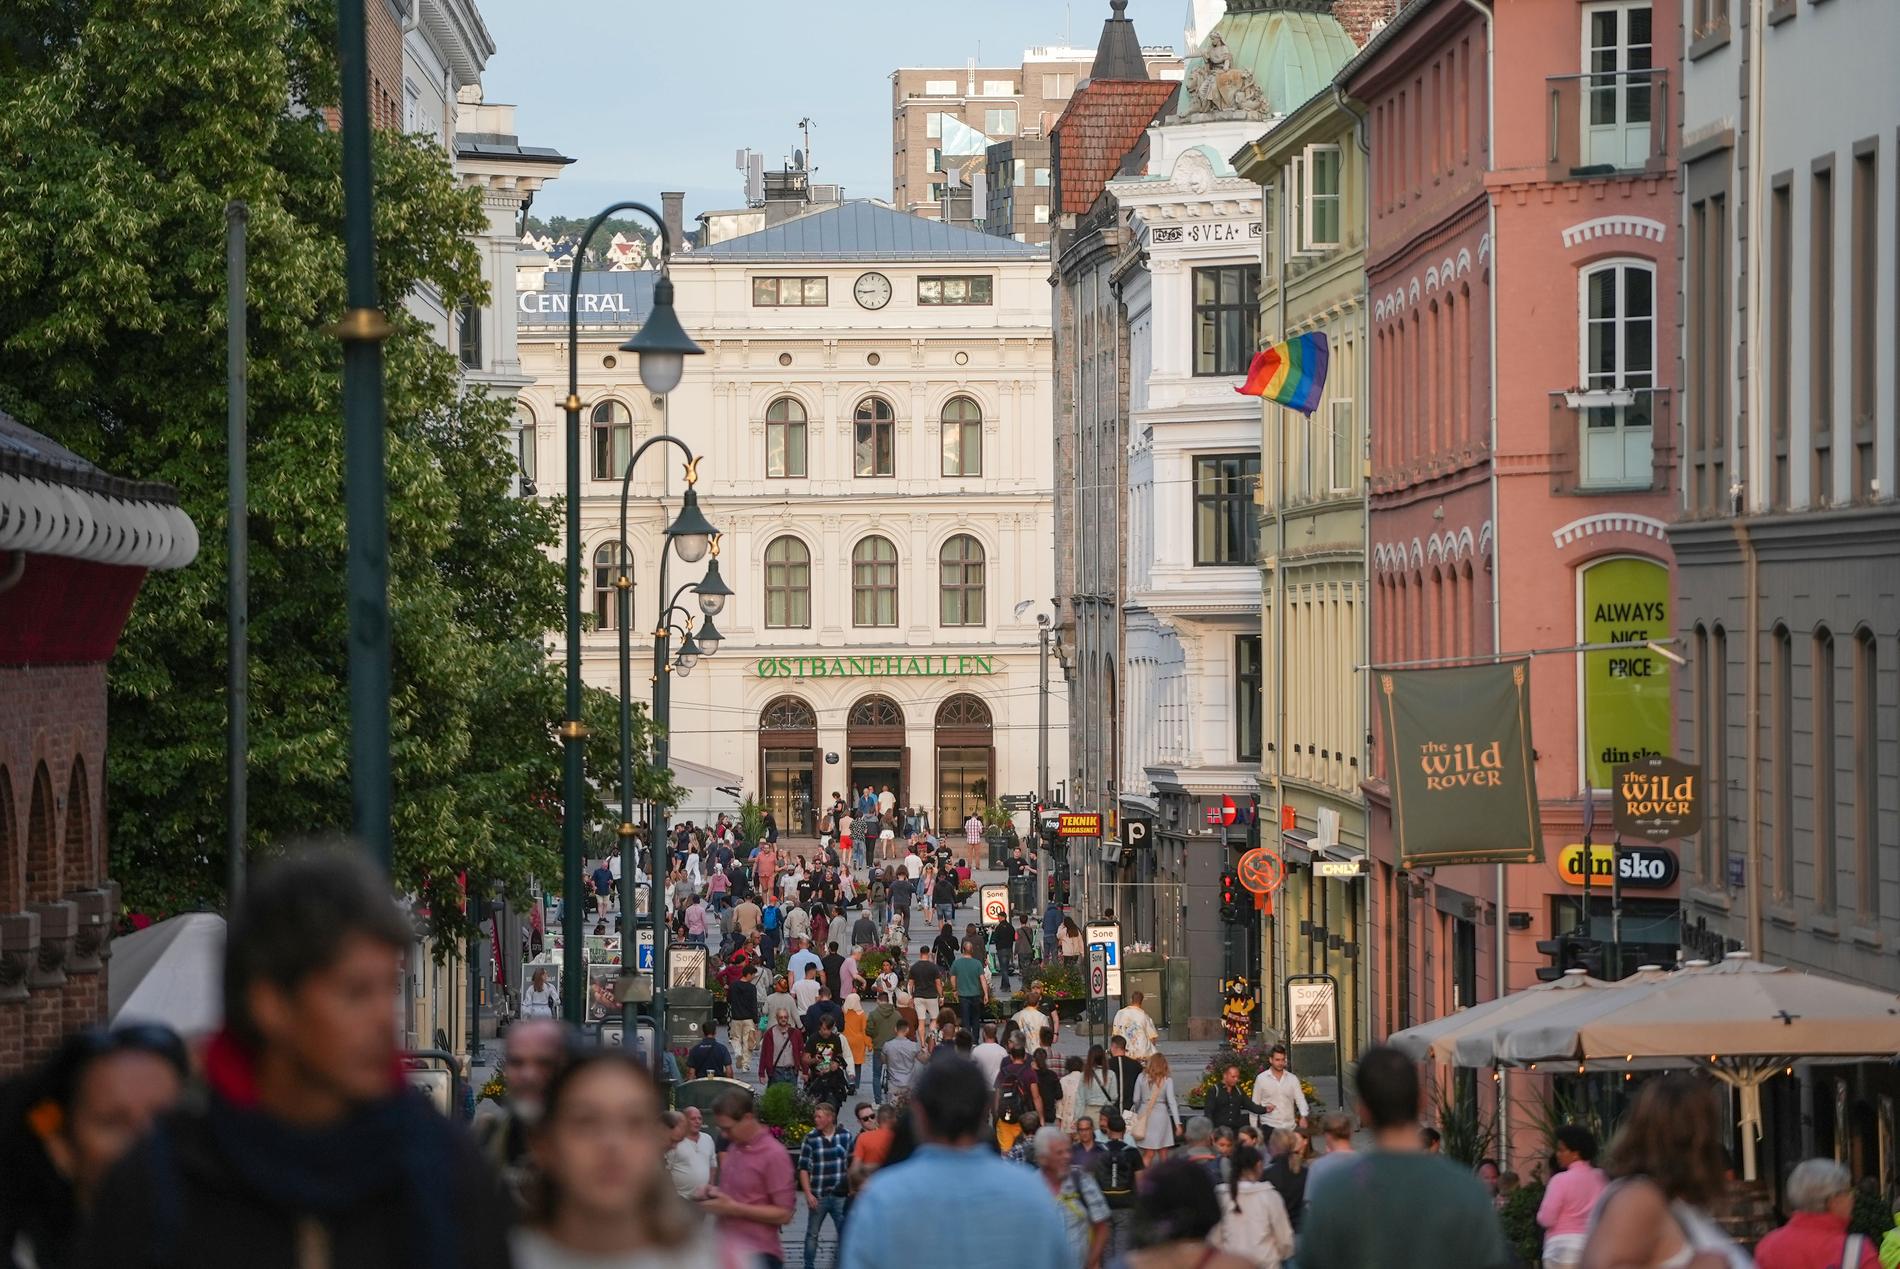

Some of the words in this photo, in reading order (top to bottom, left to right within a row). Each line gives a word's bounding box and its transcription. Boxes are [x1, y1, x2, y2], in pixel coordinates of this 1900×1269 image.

[1192, 224, 1234, 241] SVEA
[1595, 603, 1664, 622] ALWAYS
[1611, 630, 1648, 649] NICE
[757, 655, 994, 678] ØSTBANEHALLEN
[1609, 658, 1651, 677] PRICE
[1601, 748, 1629, 763] din
[1062, 816, 1097, 826] TEKNIK
[1322, 864, 1359, 875] ONLY
[1619, 853, 1666, 879] sko
[990, 905, 1002, 916] 30
[641, 932, 653, 941] So
[1093, 929, 1114, 938] Sone
[675, 953, 699, 962] Son
[1091, 953, 1103, 963] Sone
[611, 1032, 645, 1046] Se
